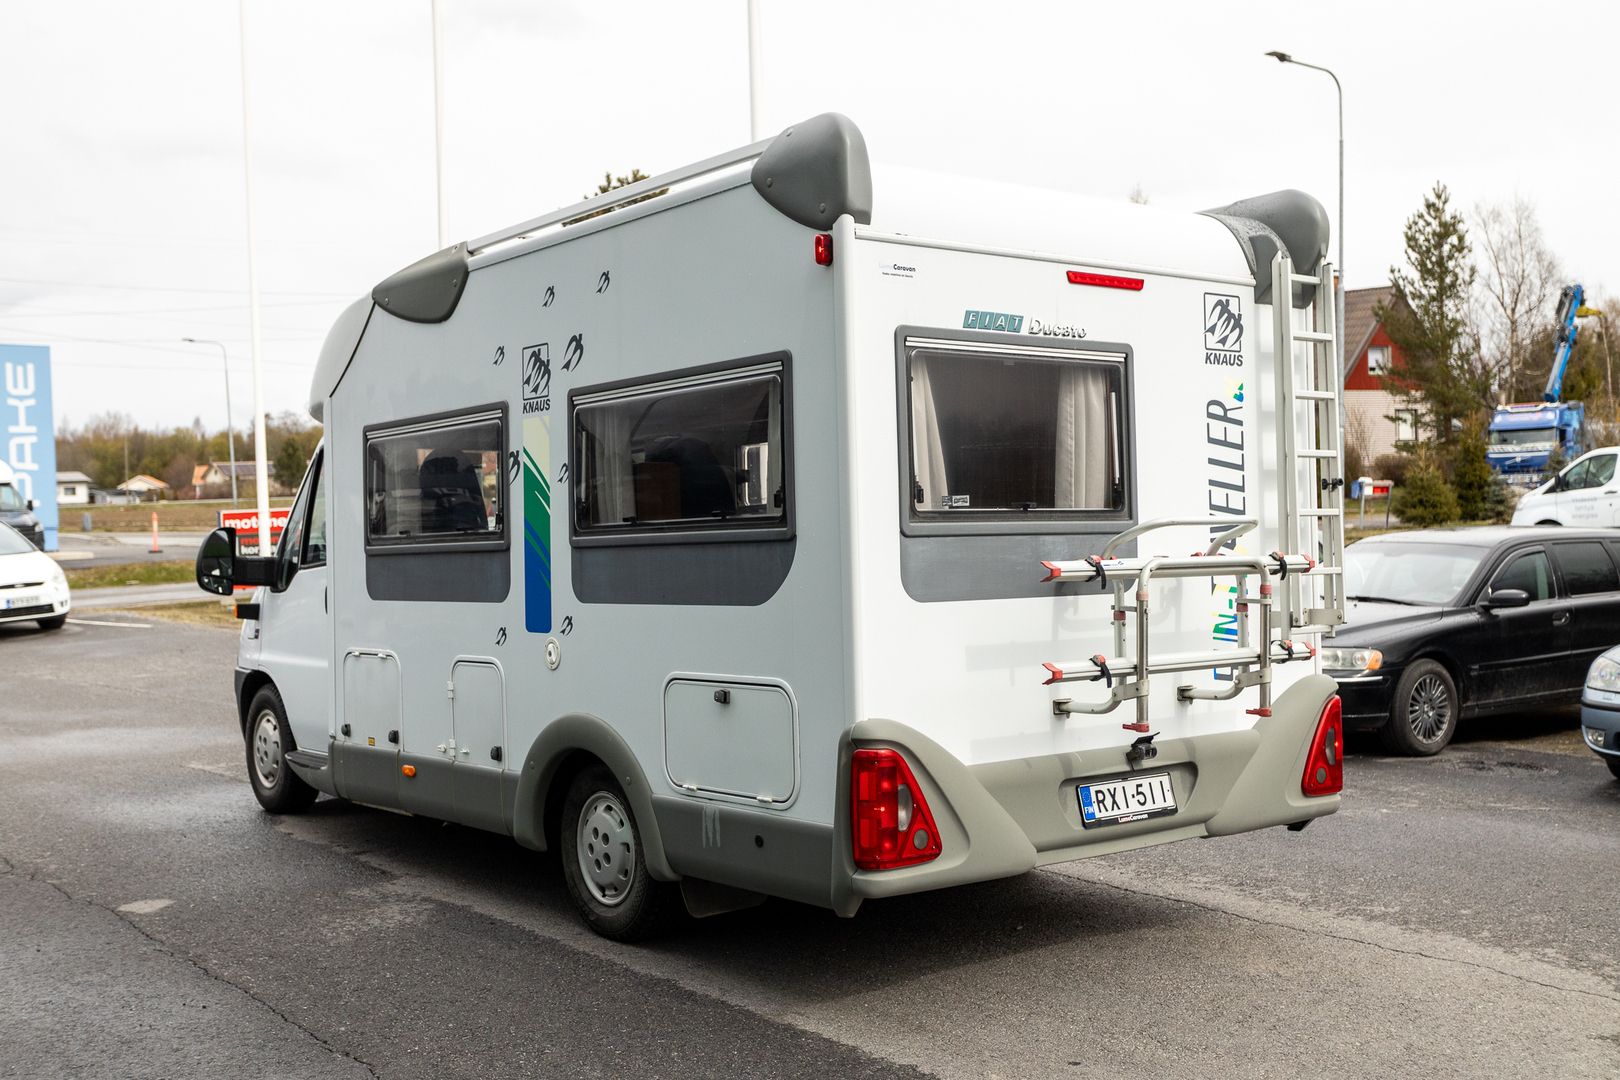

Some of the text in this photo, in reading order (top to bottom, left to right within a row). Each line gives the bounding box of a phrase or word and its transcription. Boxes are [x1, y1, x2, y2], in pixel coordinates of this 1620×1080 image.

[964, 310, 1087, 339] FIAT Ducato
[1204, 351, 1244, 367] KNAUS
[522, 398, 551, 414] KNAUS
[1094, 780, 1167, 813] RXI-511
